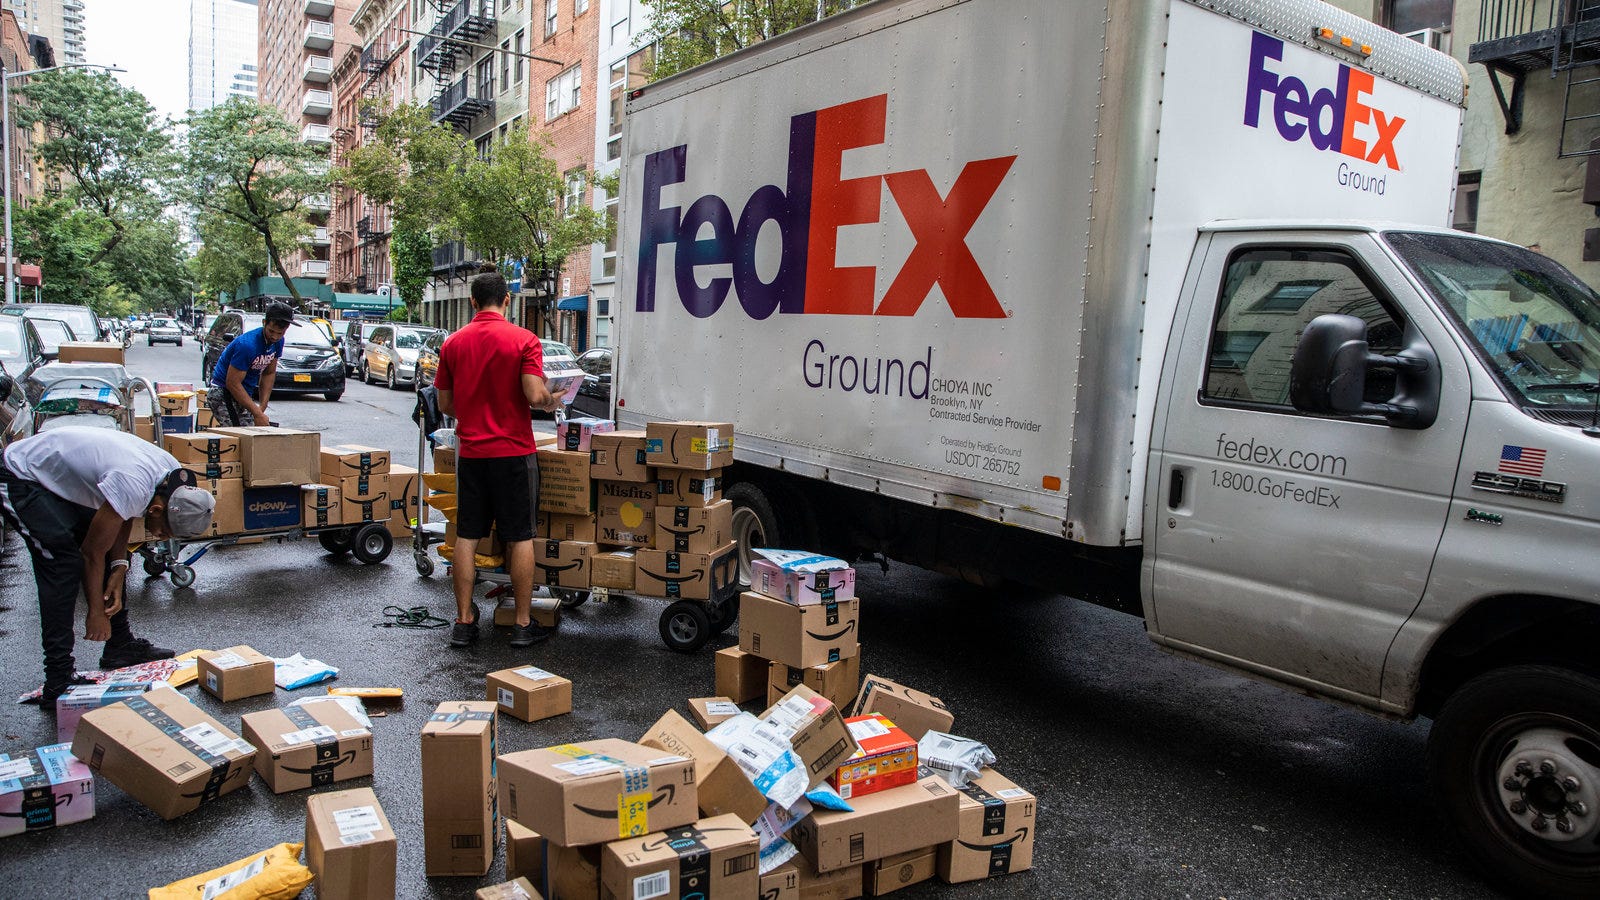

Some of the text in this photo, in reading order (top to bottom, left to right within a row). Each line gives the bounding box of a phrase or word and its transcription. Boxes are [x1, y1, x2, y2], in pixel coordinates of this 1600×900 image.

[1243, 29, 1407, 172] FedEx
[1337, 162, 1387, 197] Ground
[635, 93, 1018, 320] FedEx
[802, 339, 932, 400] Ground
[931, 378, 993, 397] CHOYA INC
[930, 395, 984, 411] Brooklyn, NY
[929, 407, 1042, 433] Contracted Service Provider
[940, 435, 1022, 458] Operated by FedEx Ground
[1216, 432, 1348, 477] fedex.com
[945, 450, 1021, 476] USDOT 265752
[602, 483, 653, 500] Misfits
[1210, 468, 1342, 510] 1.800.GoFedEx
